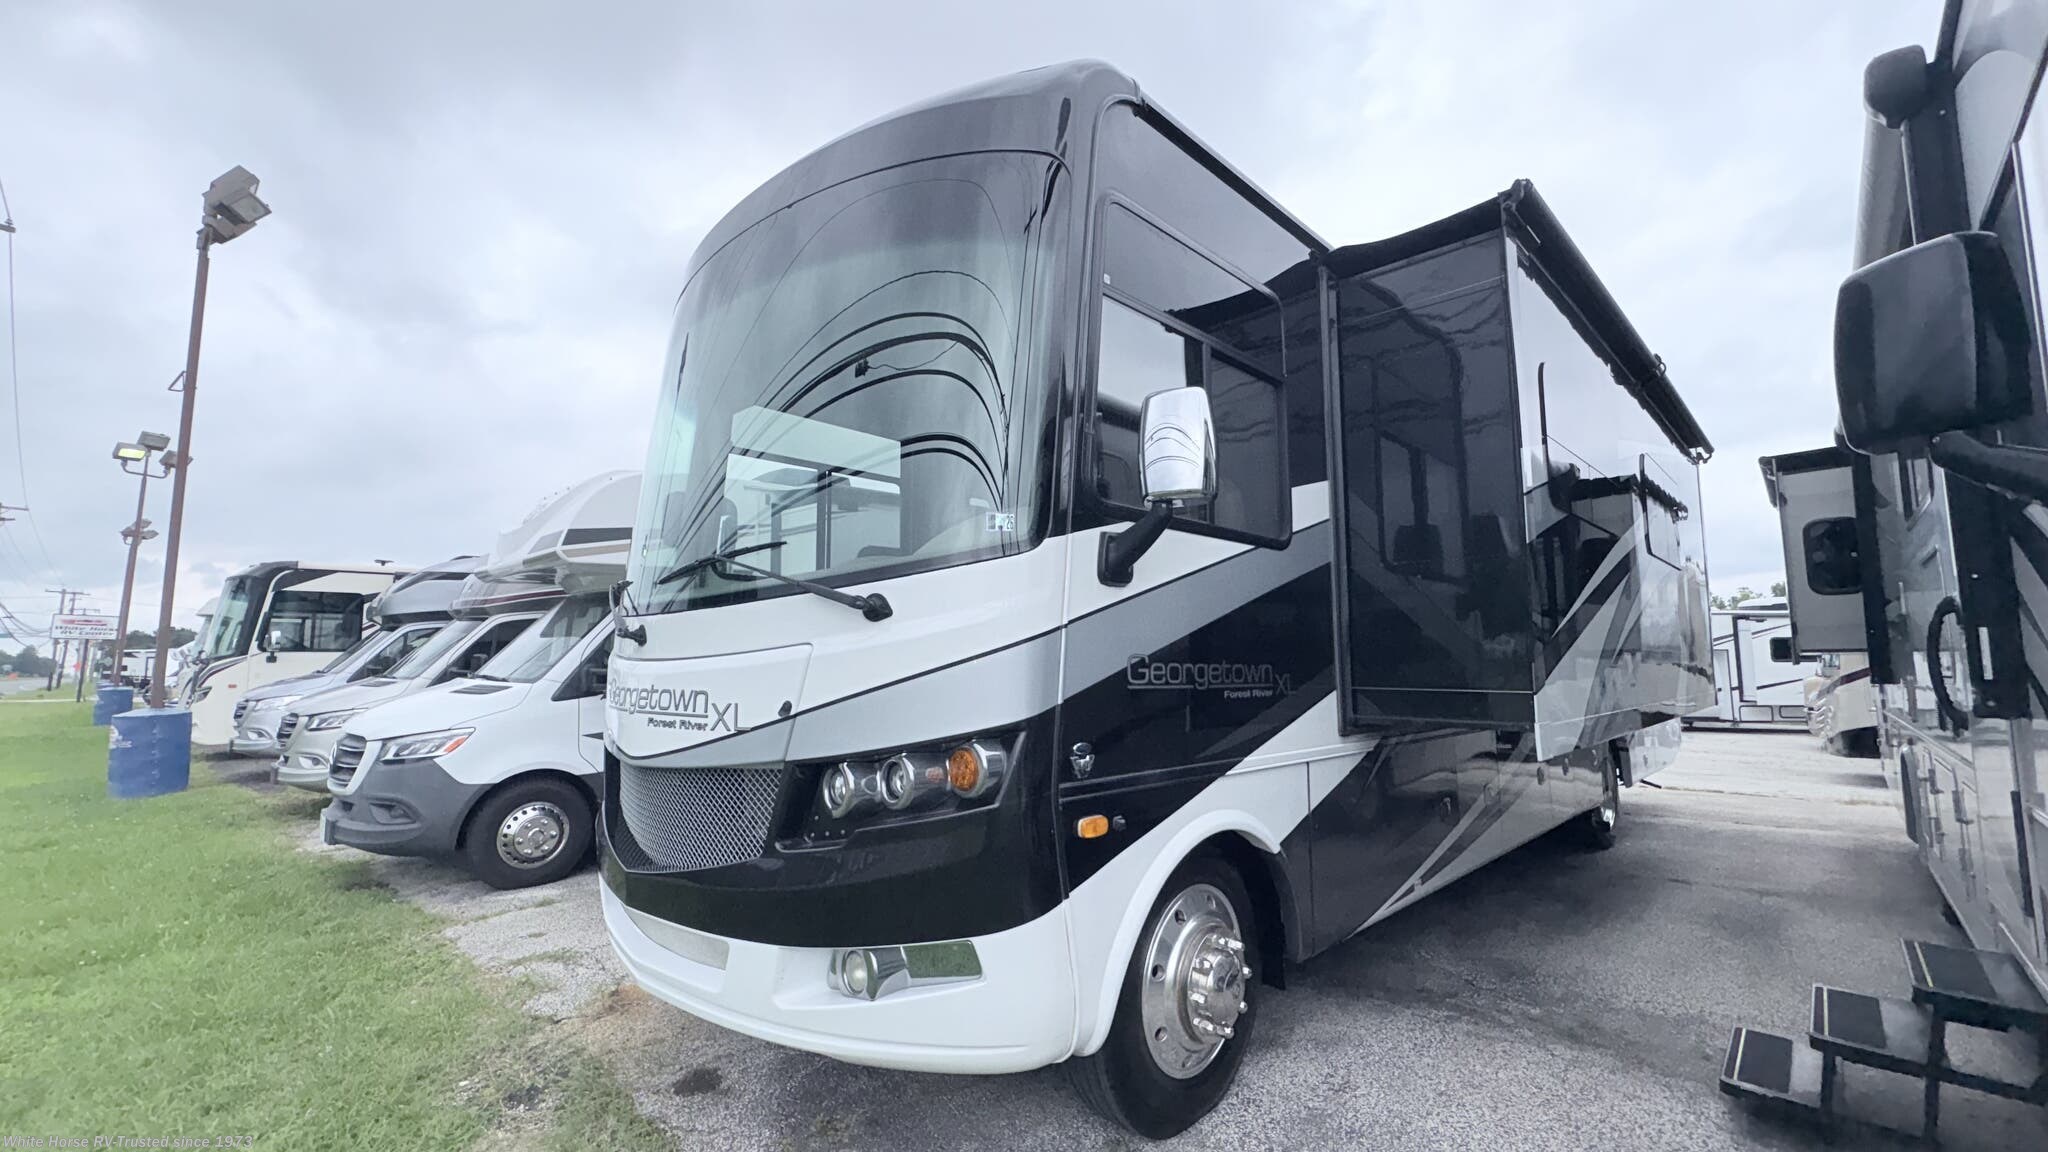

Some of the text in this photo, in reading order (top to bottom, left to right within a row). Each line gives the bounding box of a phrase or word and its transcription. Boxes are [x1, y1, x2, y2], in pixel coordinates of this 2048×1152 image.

[1127, 653, 1297, 695] Georgetown XL
[609, 678, 752, 732] Georgetown XL
[1223, 688, 1273, 699] Forest River
[647, 717, 708, 731] Forest River
